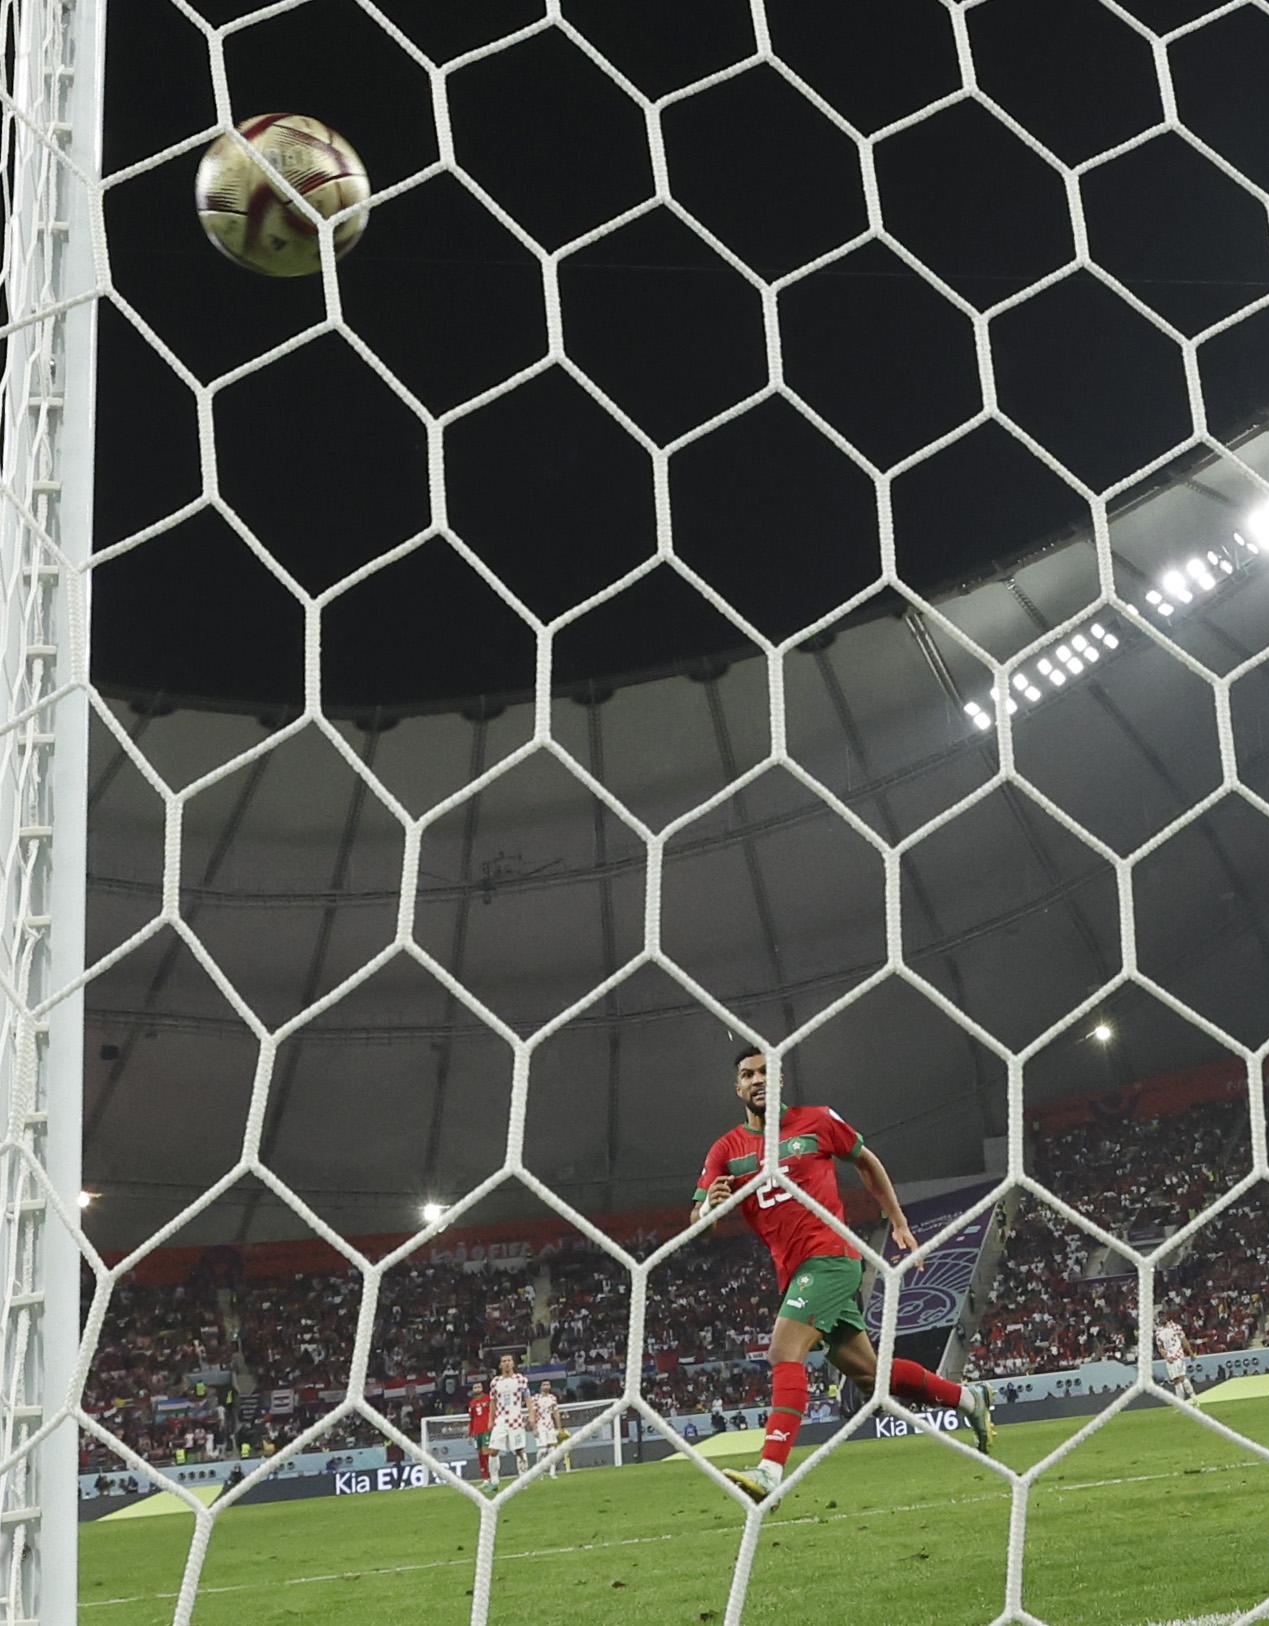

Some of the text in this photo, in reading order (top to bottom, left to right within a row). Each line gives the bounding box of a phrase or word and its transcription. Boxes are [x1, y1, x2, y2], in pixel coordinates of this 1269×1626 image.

[875, 1416, 909, 1438] Kia
[335, 1471, 371, 1496] Kia
[376, 1464, 426, 1491] EV6
